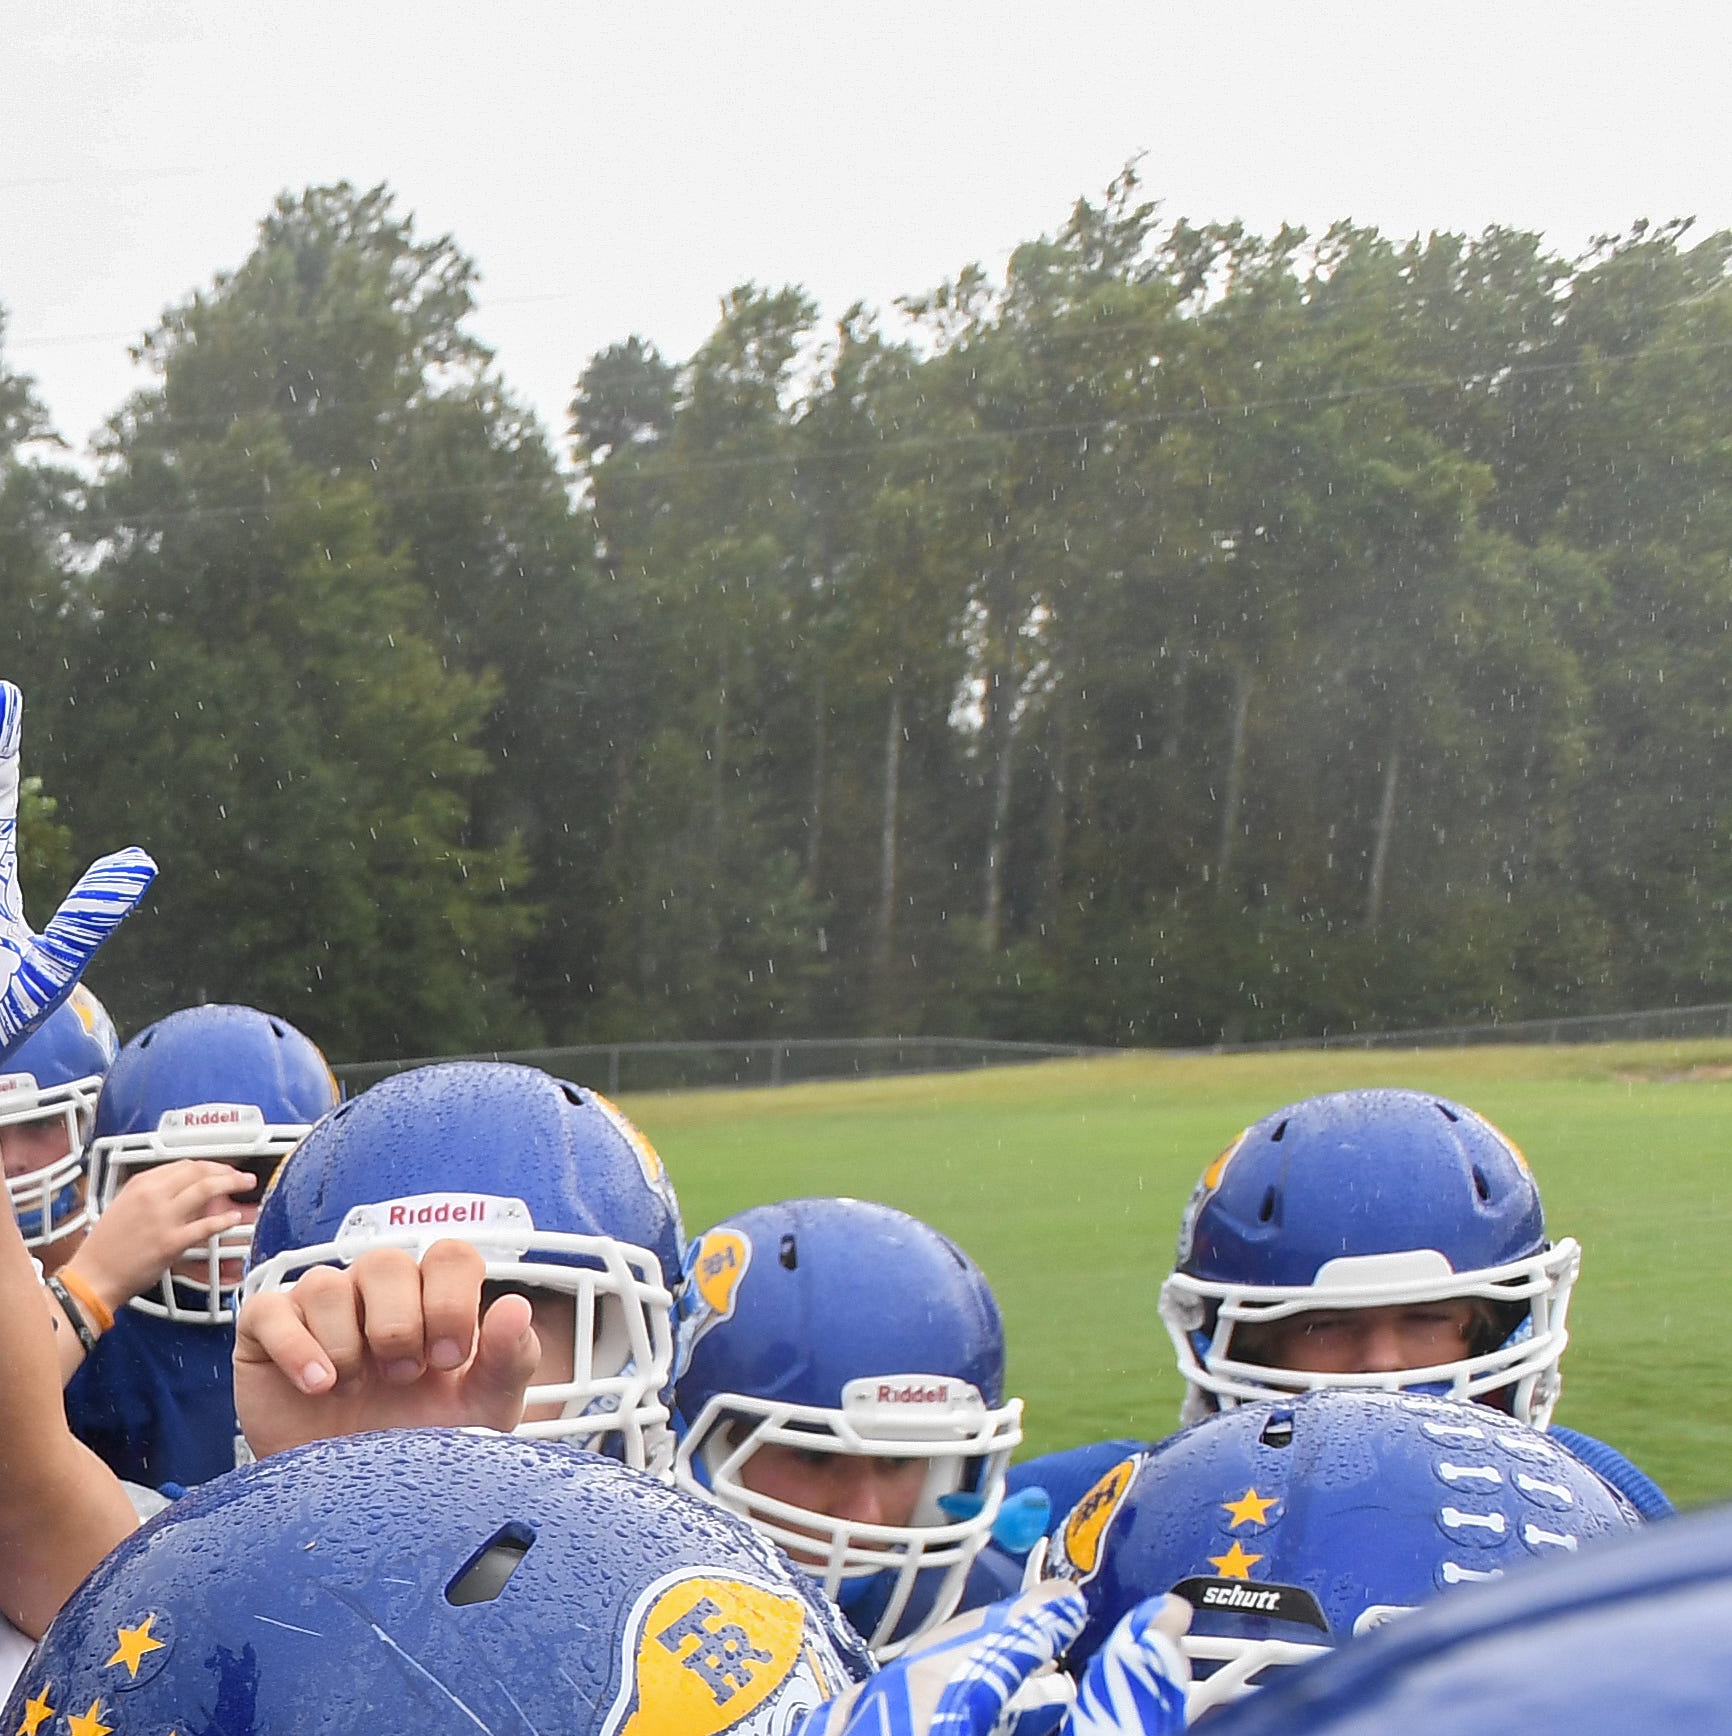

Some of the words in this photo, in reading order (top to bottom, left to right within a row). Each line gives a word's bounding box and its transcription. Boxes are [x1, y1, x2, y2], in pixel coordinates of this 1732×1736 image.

[184, 1110, 240, 1126] Riddell
[388, 1201, 486, 1226] Riddell
[878, 1384, 948, 1403] Riddell
[1202, 1584, 1281, 1611] schutt
